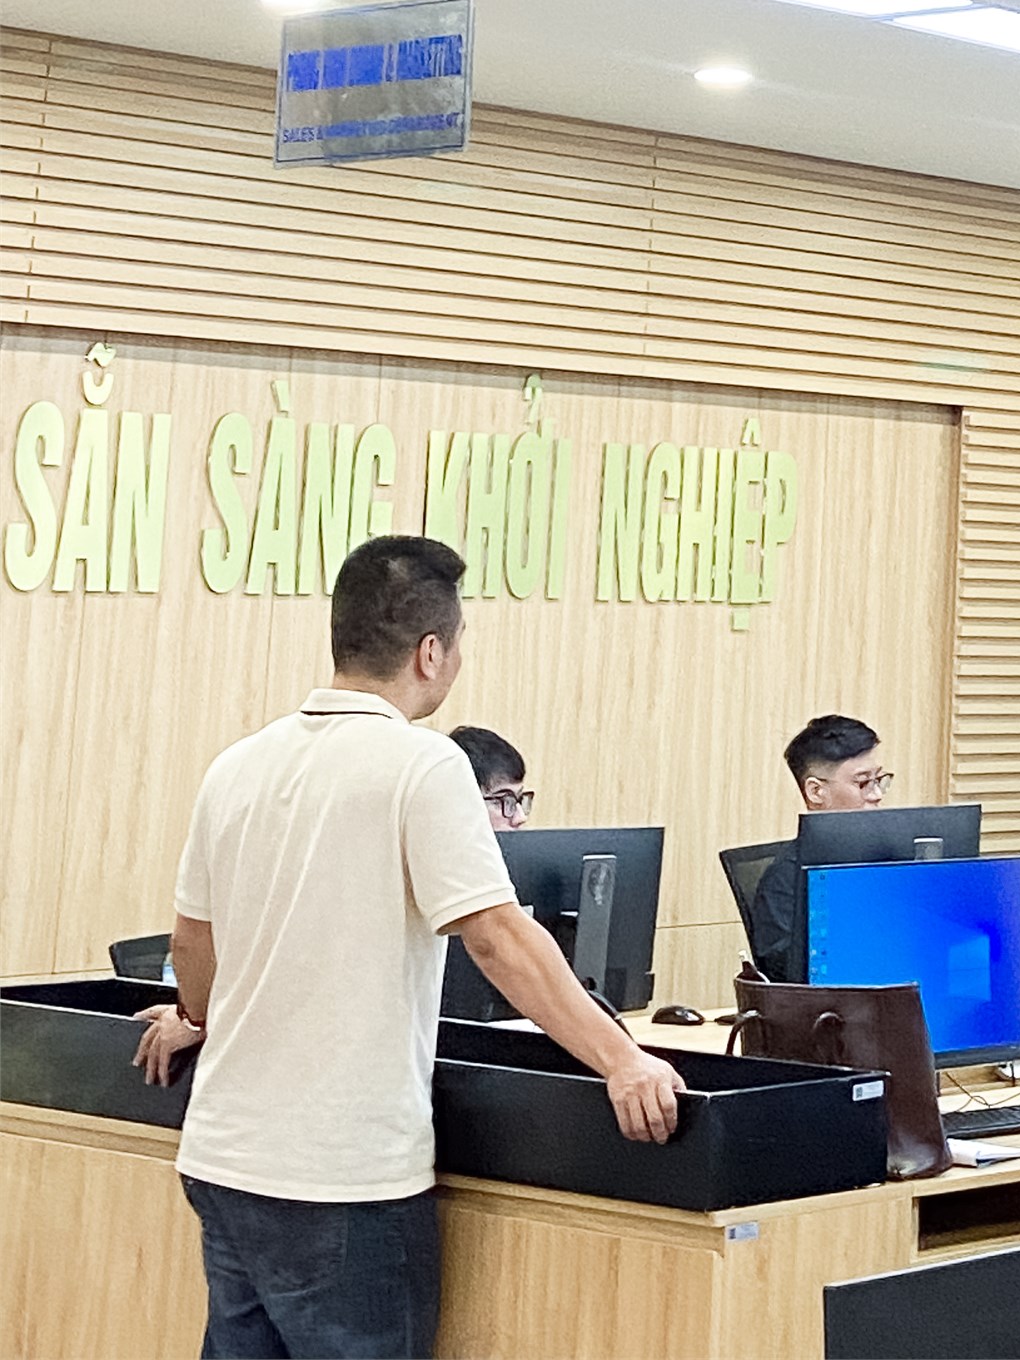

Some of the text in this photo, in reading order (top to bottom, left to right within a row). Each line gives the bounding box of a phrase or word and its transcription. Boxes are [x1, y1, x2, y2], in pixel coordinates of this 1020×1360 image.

[4, 342, 798, 631] SẴN SÀNG KHỞI NGHIỆP
